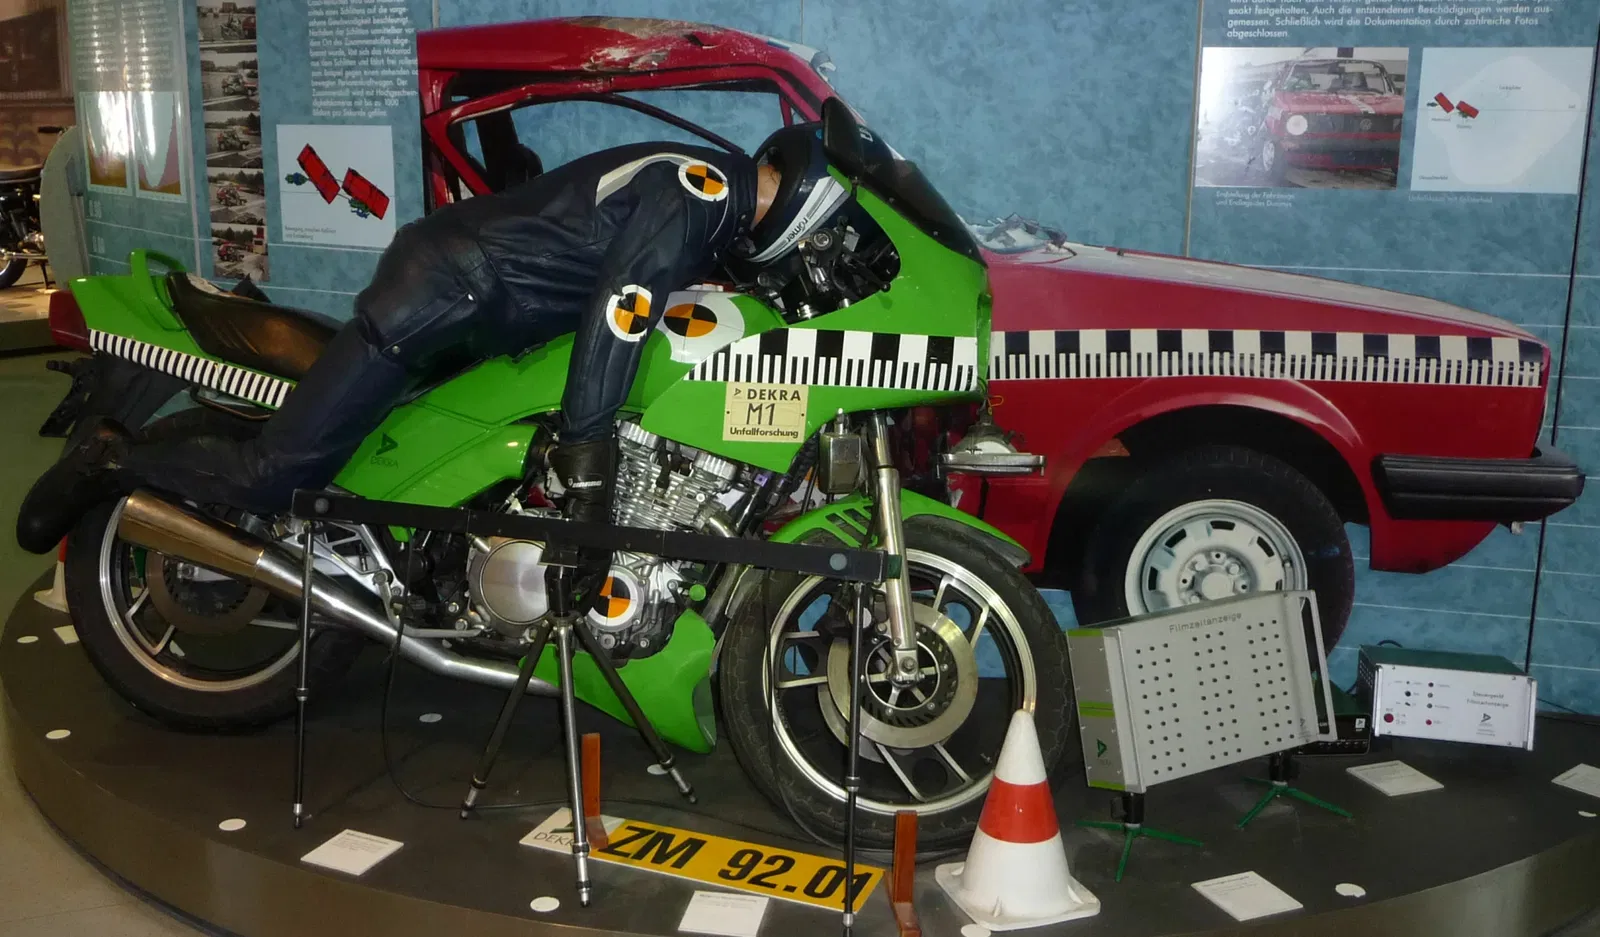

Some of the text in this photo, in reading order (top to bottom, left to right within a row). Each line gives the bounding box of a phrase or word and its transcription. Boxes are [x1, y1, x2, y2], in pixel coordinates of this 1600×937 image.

[1228, 5, 1252, 15] exakt
[1255, 5, 1309, 16] festgehalten.
[1312, 5, 1335, 14] Auch
[1338, 5, 1352, 14] die
[1355, 5, 1414, 14] entstandenen
[1418, 4, 1492, 16] Beschädigungen
[1496, 4, 1530, 13] werden
[1275, 17, 1320, 26] Schließlich
[1324, 16, 1344, 26] wird
[1346, 16, 1361, 26] die
[1364, 16, 1431, 26] Dokumentation
[1434, 16, 1460, 26] durch
[1464, 15, 1511, 26] zahlreiche
[1514, 16, 1539, 25] Fotos
[747, 388, 801, 401] DEKRA
[746, 402, 775, 426] M1
[730, 427, 799, 439] Unfallforschung
[1169, 613, 1242, 633] Filmzeitanzeige
[534, 831, 575, 847] DEKR
[598, 825, 873, 904] ZM 92.01
